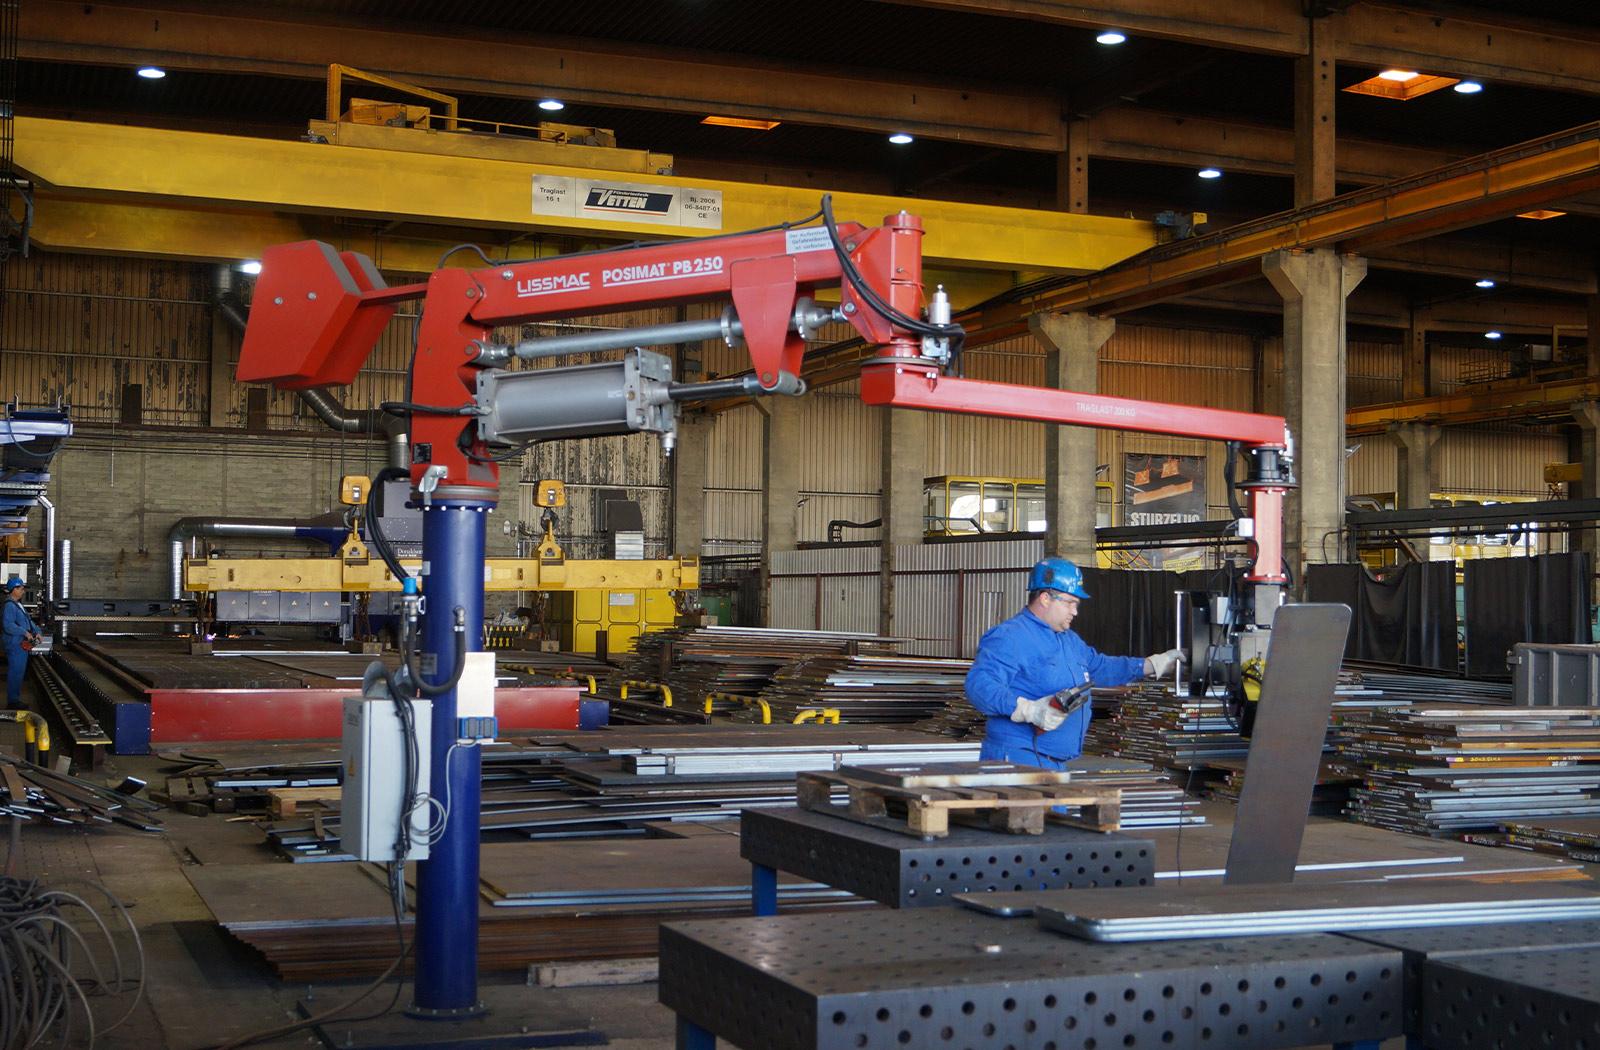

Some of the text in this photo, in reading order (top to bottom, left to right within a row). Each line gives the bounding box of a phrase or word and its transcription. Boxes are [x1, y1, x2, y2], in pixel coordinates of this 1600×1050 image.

[540, 187, 566, 195] Traglast
[591, 188, 648, 209] VETTEN
[673, 260, 692, 275] PB
[693, 256, 723, 273] 250
[517, 272, 590, 293] LISSMAC
[1075, 401, 1113, 415] TRAGLAST
